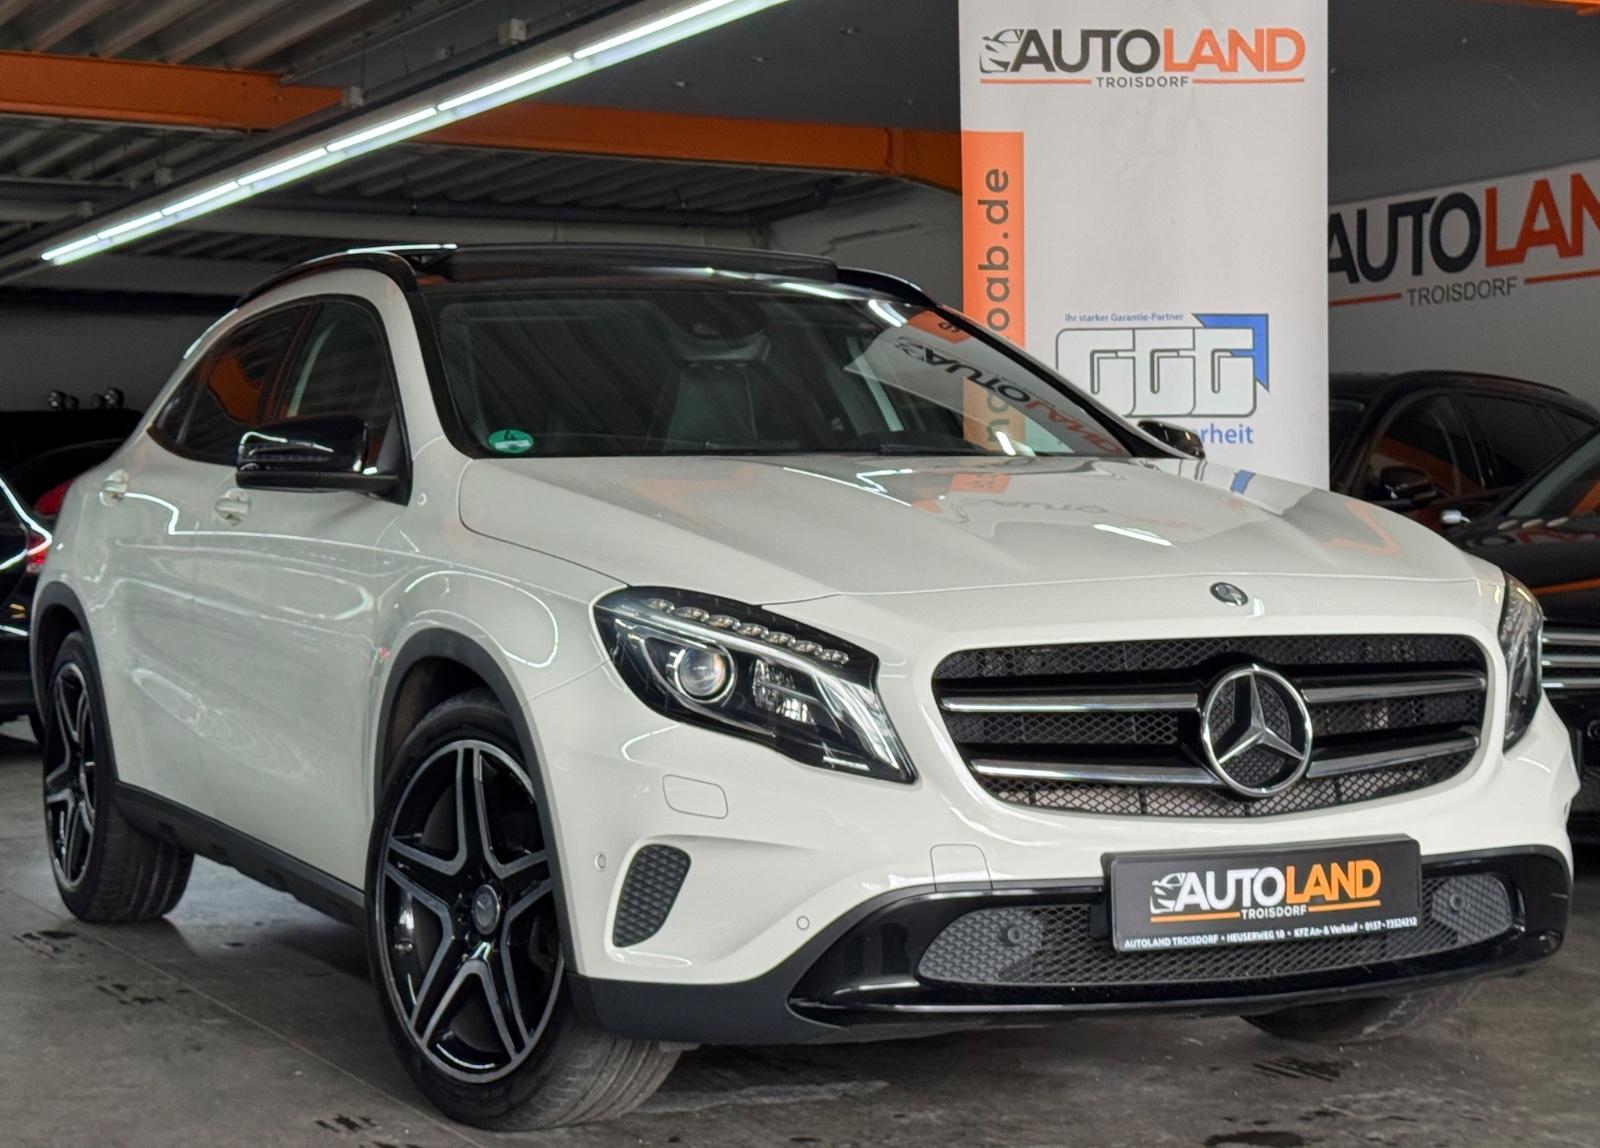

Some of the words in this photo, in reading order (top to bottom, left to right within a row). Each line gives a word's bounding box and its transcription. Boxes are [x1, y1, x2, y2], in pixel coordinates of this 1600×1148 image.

[1009, 28, 1306, 74] AUTOLAND
[1096, 76, 1190, 88] TROISDORF
[1328, 172, 1600, 284] AUTOLAN
[1407, 276, 1519, 306] TROISDORF
[1064, 313, 1077, 322] Ihr
[1079, 313, 1109, 322] starker
[1110, 312, 1185, 322] Garantie-Partner
[1199, 422, 1254, 444] rheit
[1172, 859, 1382, 913] AUTOLAND
[1240, 904, 1307, 921] TROISDORF
[1124, 936, 1170, 949] AUTOLAND
[1172, 934, 1219, 946] TROISDORF
